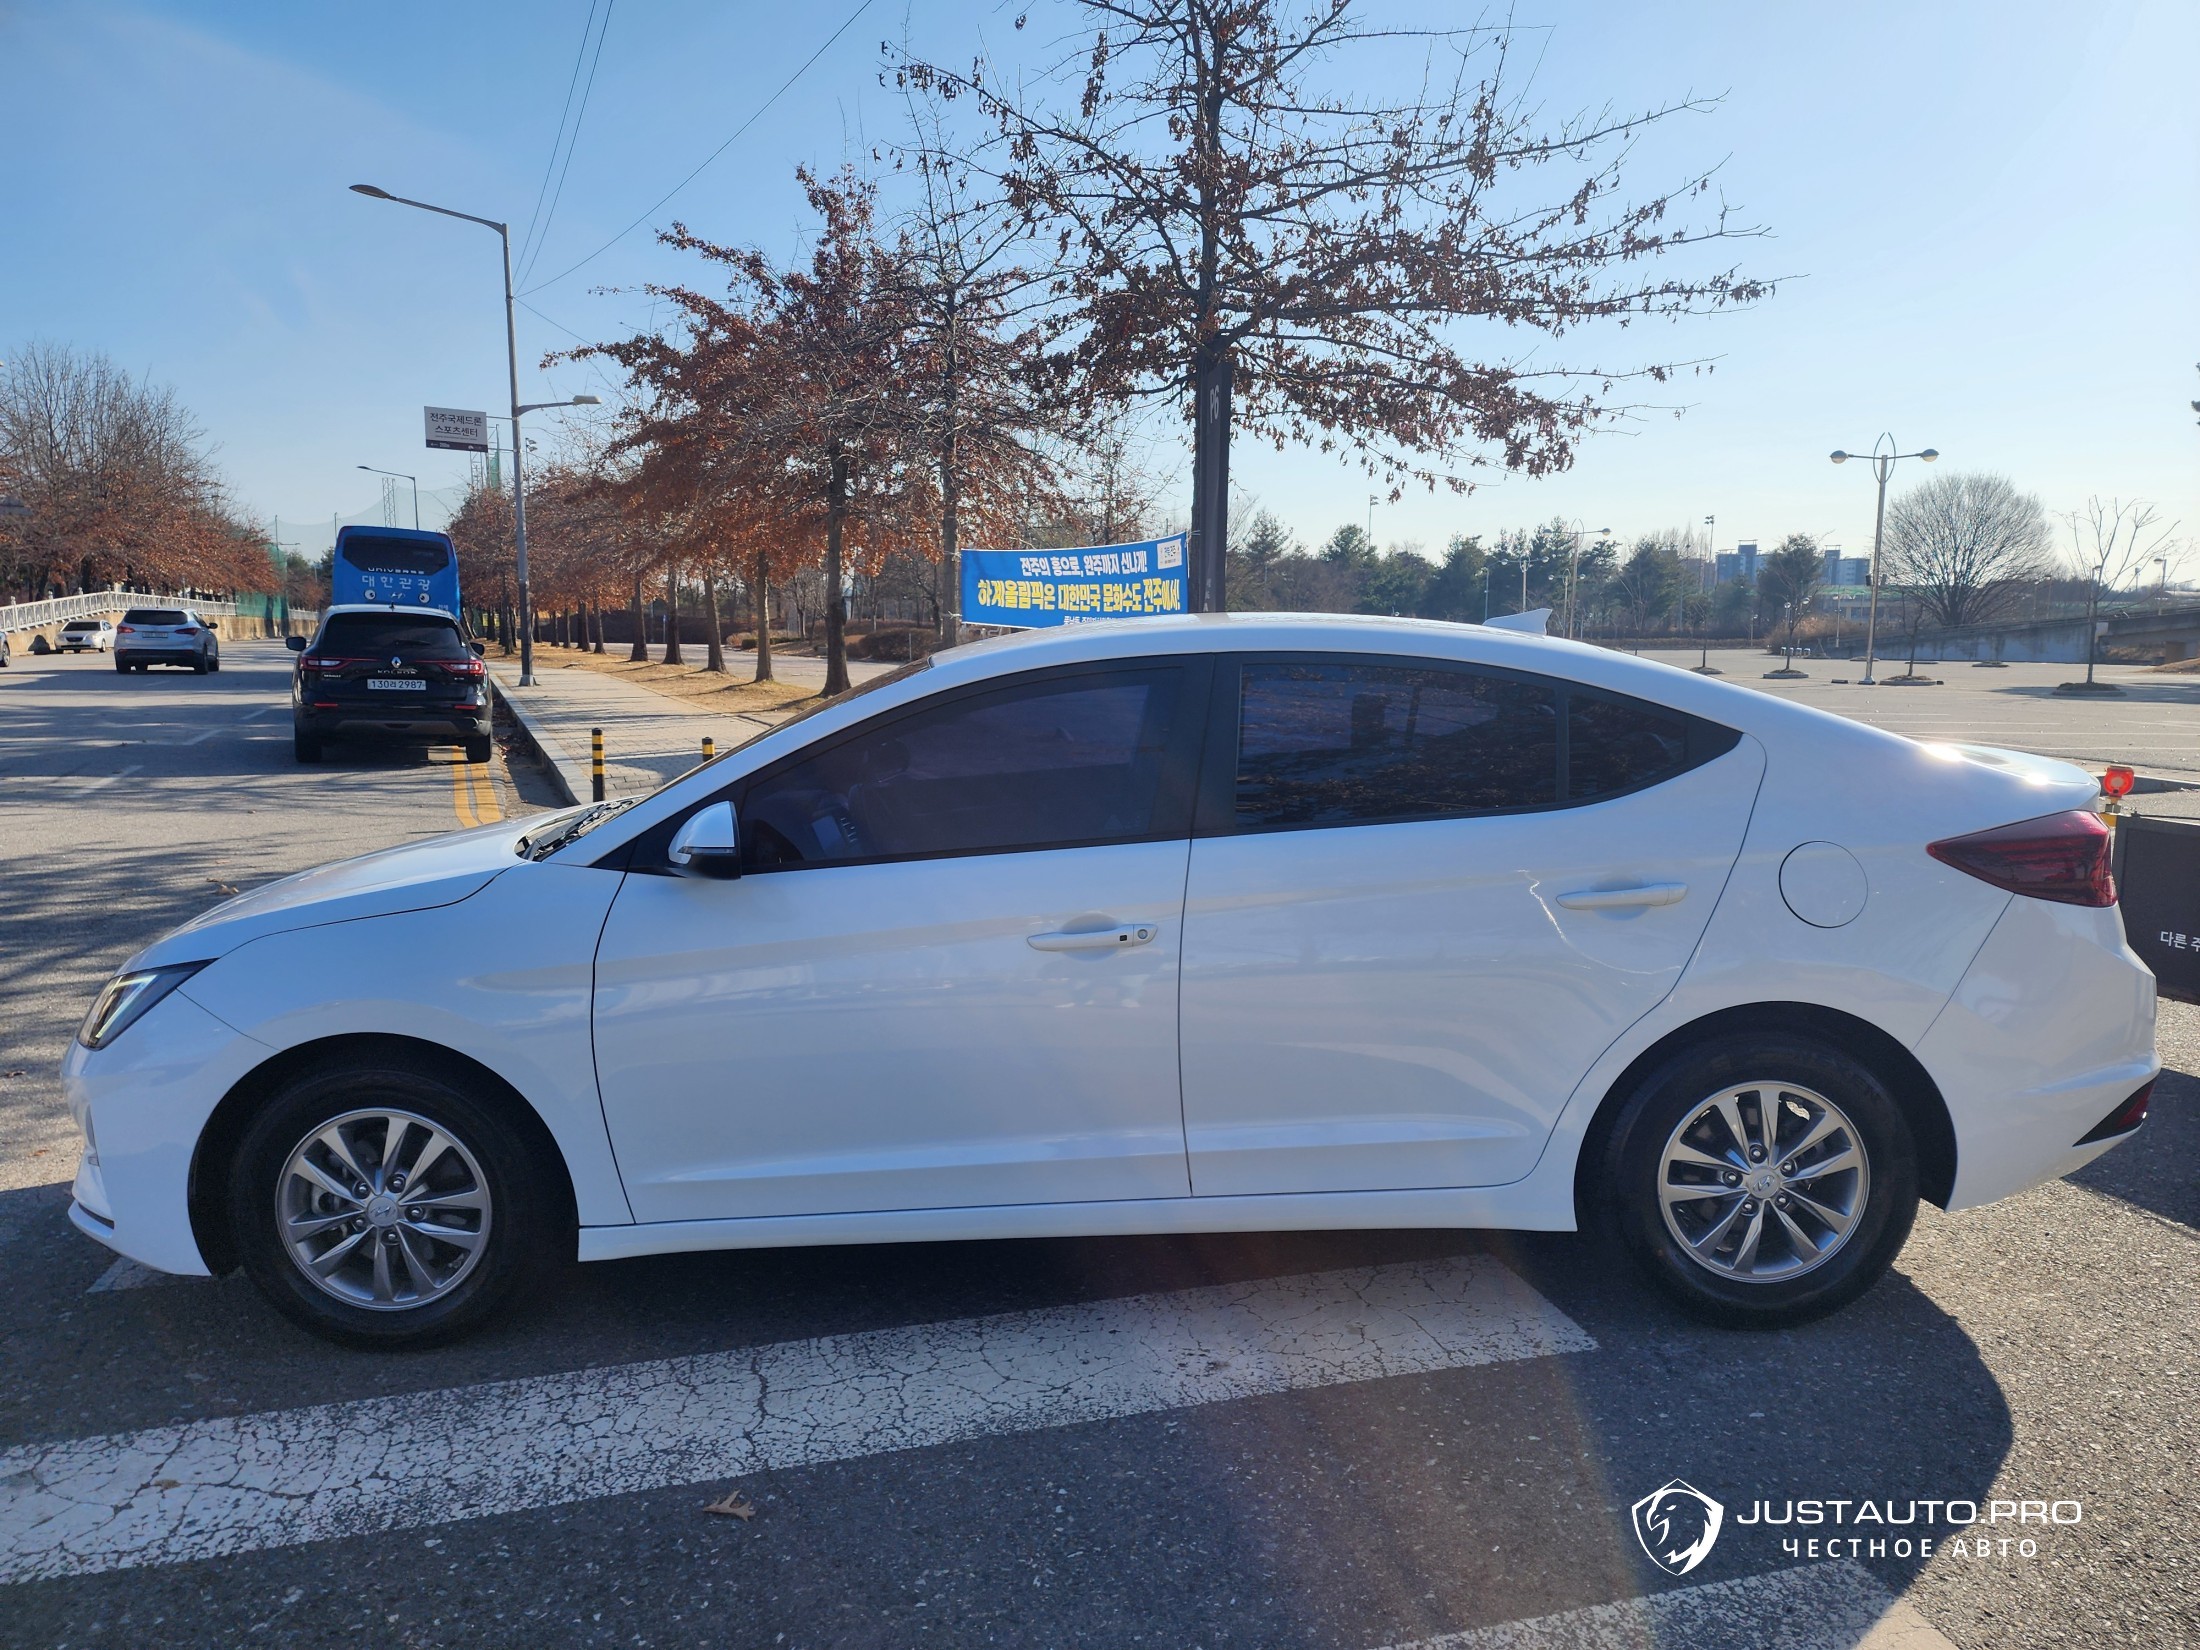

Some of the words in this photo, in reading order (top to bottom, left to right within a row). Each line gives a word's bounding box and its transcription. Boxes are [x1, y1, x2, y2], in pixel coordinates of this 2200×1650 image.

[1209, 384, 1220, 424] P6
[430, 412, 482, 427] 전주국제드론
[435, 425, 478, 437] 스포츠센터
[1020, 557, 1052, 577] 전주의
[1050, 556, 1084, 577] 흥으로,
[1083, 553, 1120, 576] 완주까지
[1121, 550, 1148, 575] 신나게!
[361, 575, 431, 591] 대한관광
[978, 579, 1056, 610] 하계올림픽은
[1058, 583, 1101, 612] 대한민국
[1102, 583, 1142, 613] 문화수도
[1143, 577, 1181, 613] 전주에서!
[399, 681, 423, 689] 2987
[2160, 931, 2187, 949] 다른
